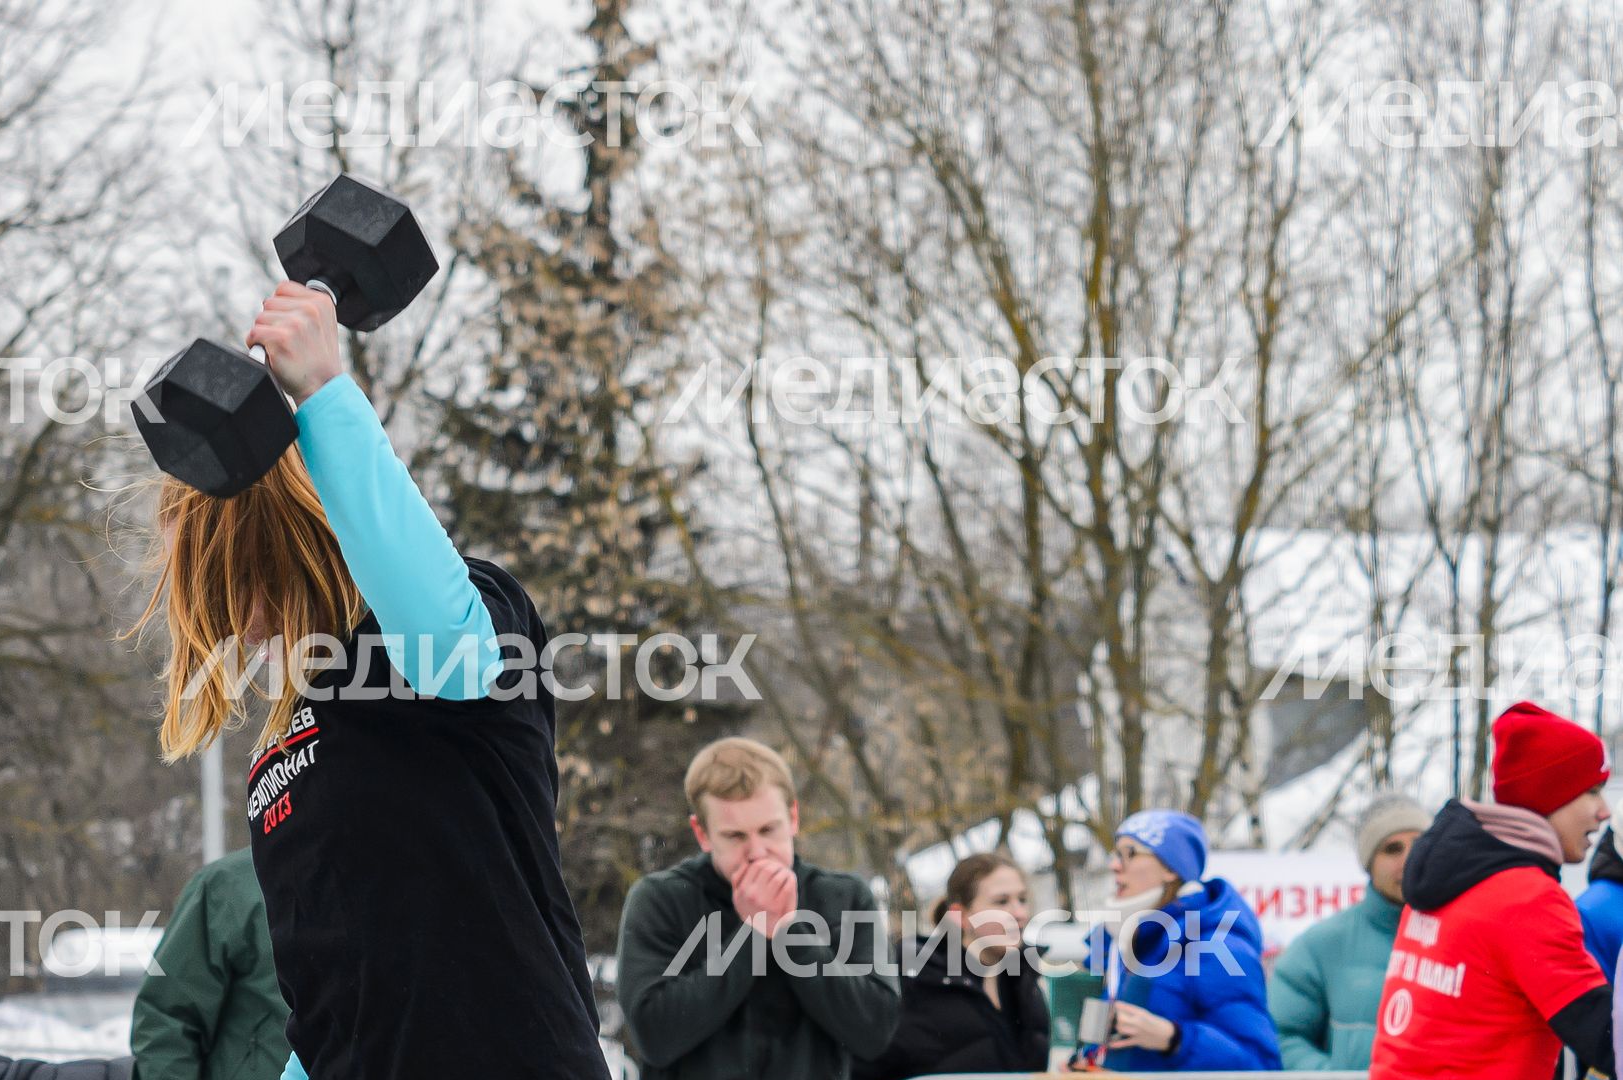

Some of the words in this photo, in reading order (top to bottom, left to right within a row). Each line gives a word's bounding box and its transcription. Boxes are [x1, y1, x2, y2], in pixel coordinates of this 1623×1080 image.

[247, 740, 319, 821] ЧЕМПИОНАТ
[263, 791, 293, 834] 2023
[1240, 884, 1365, 919] ИЗН
